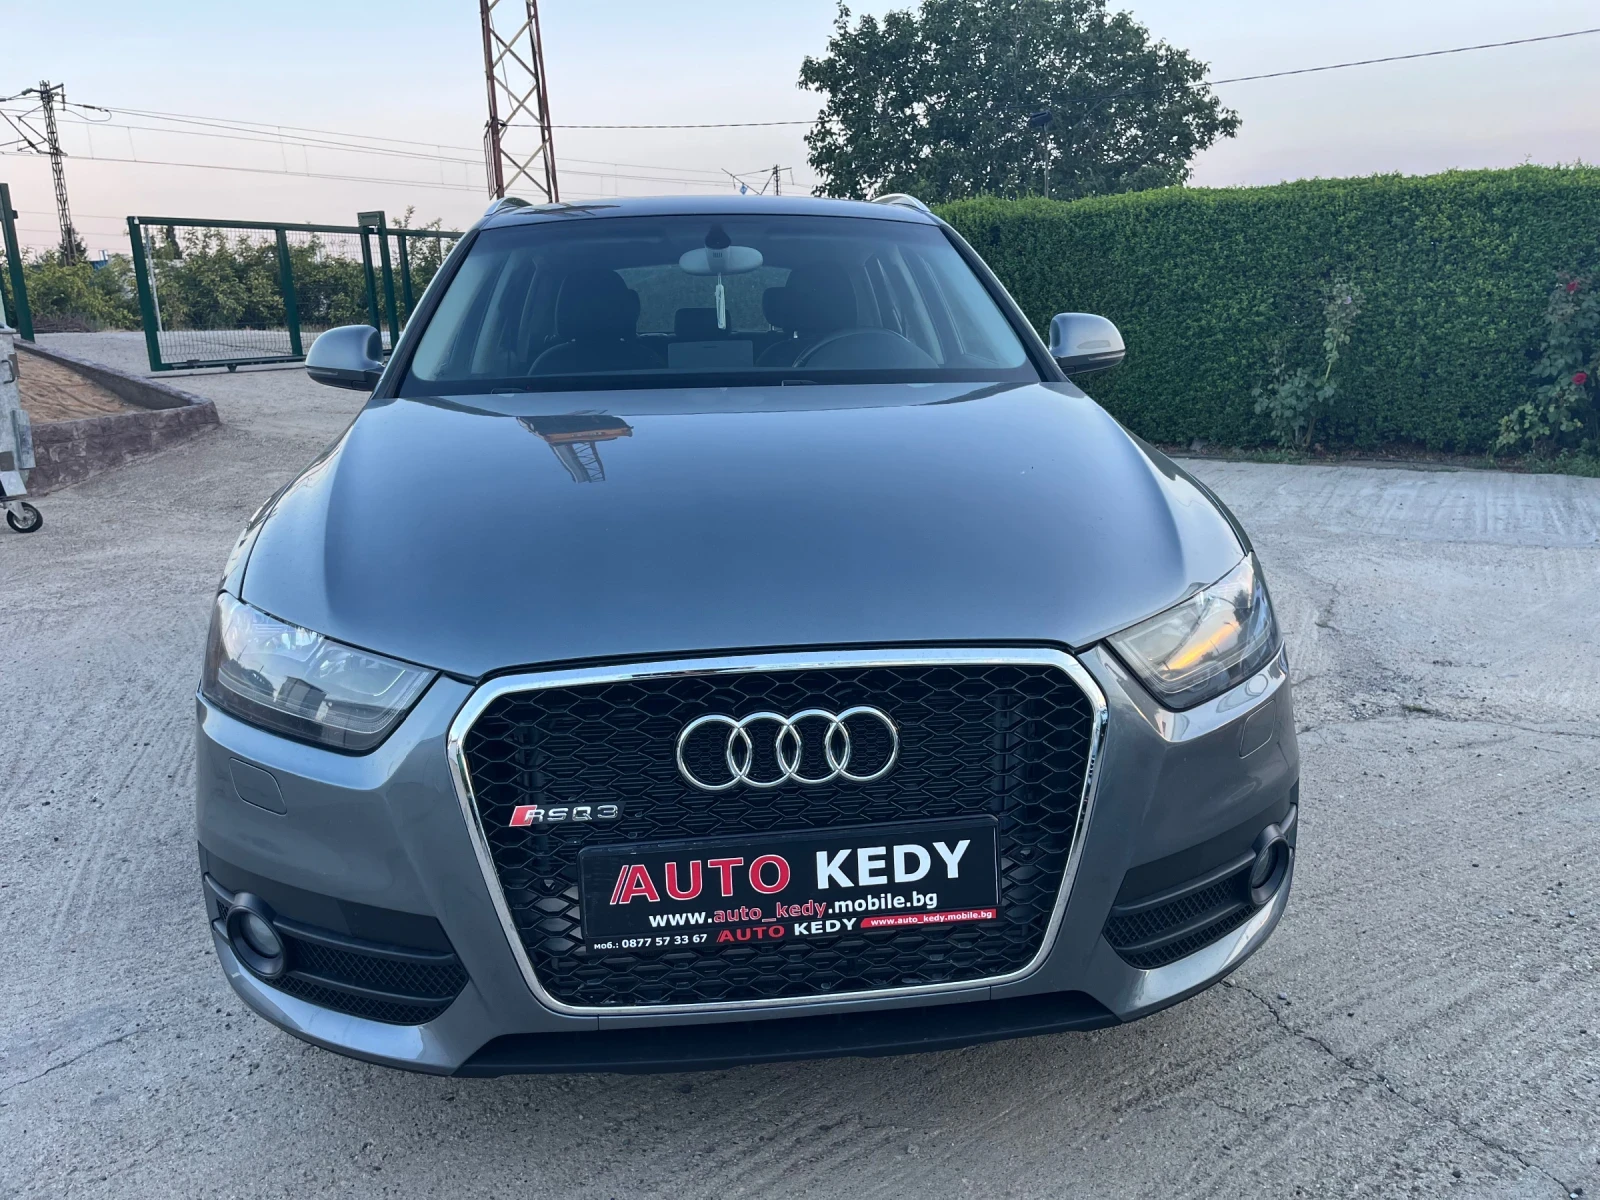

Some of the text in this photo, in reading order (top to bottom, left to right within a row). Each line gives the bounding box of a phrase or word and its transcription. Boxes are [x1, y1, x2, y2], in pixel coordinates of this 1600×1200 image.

[610, 839, 971, 905] AUTO KEDY
[648, 891, 938, 928] www.auto_kedy.mobile.bg
[870, 910, 992, 926] www.auto_kedy.mobile.bg
[593, 934, 708, 950] моб.: 0877 57 33 67
[716, 918, 857, 942] AUTO KEDY
